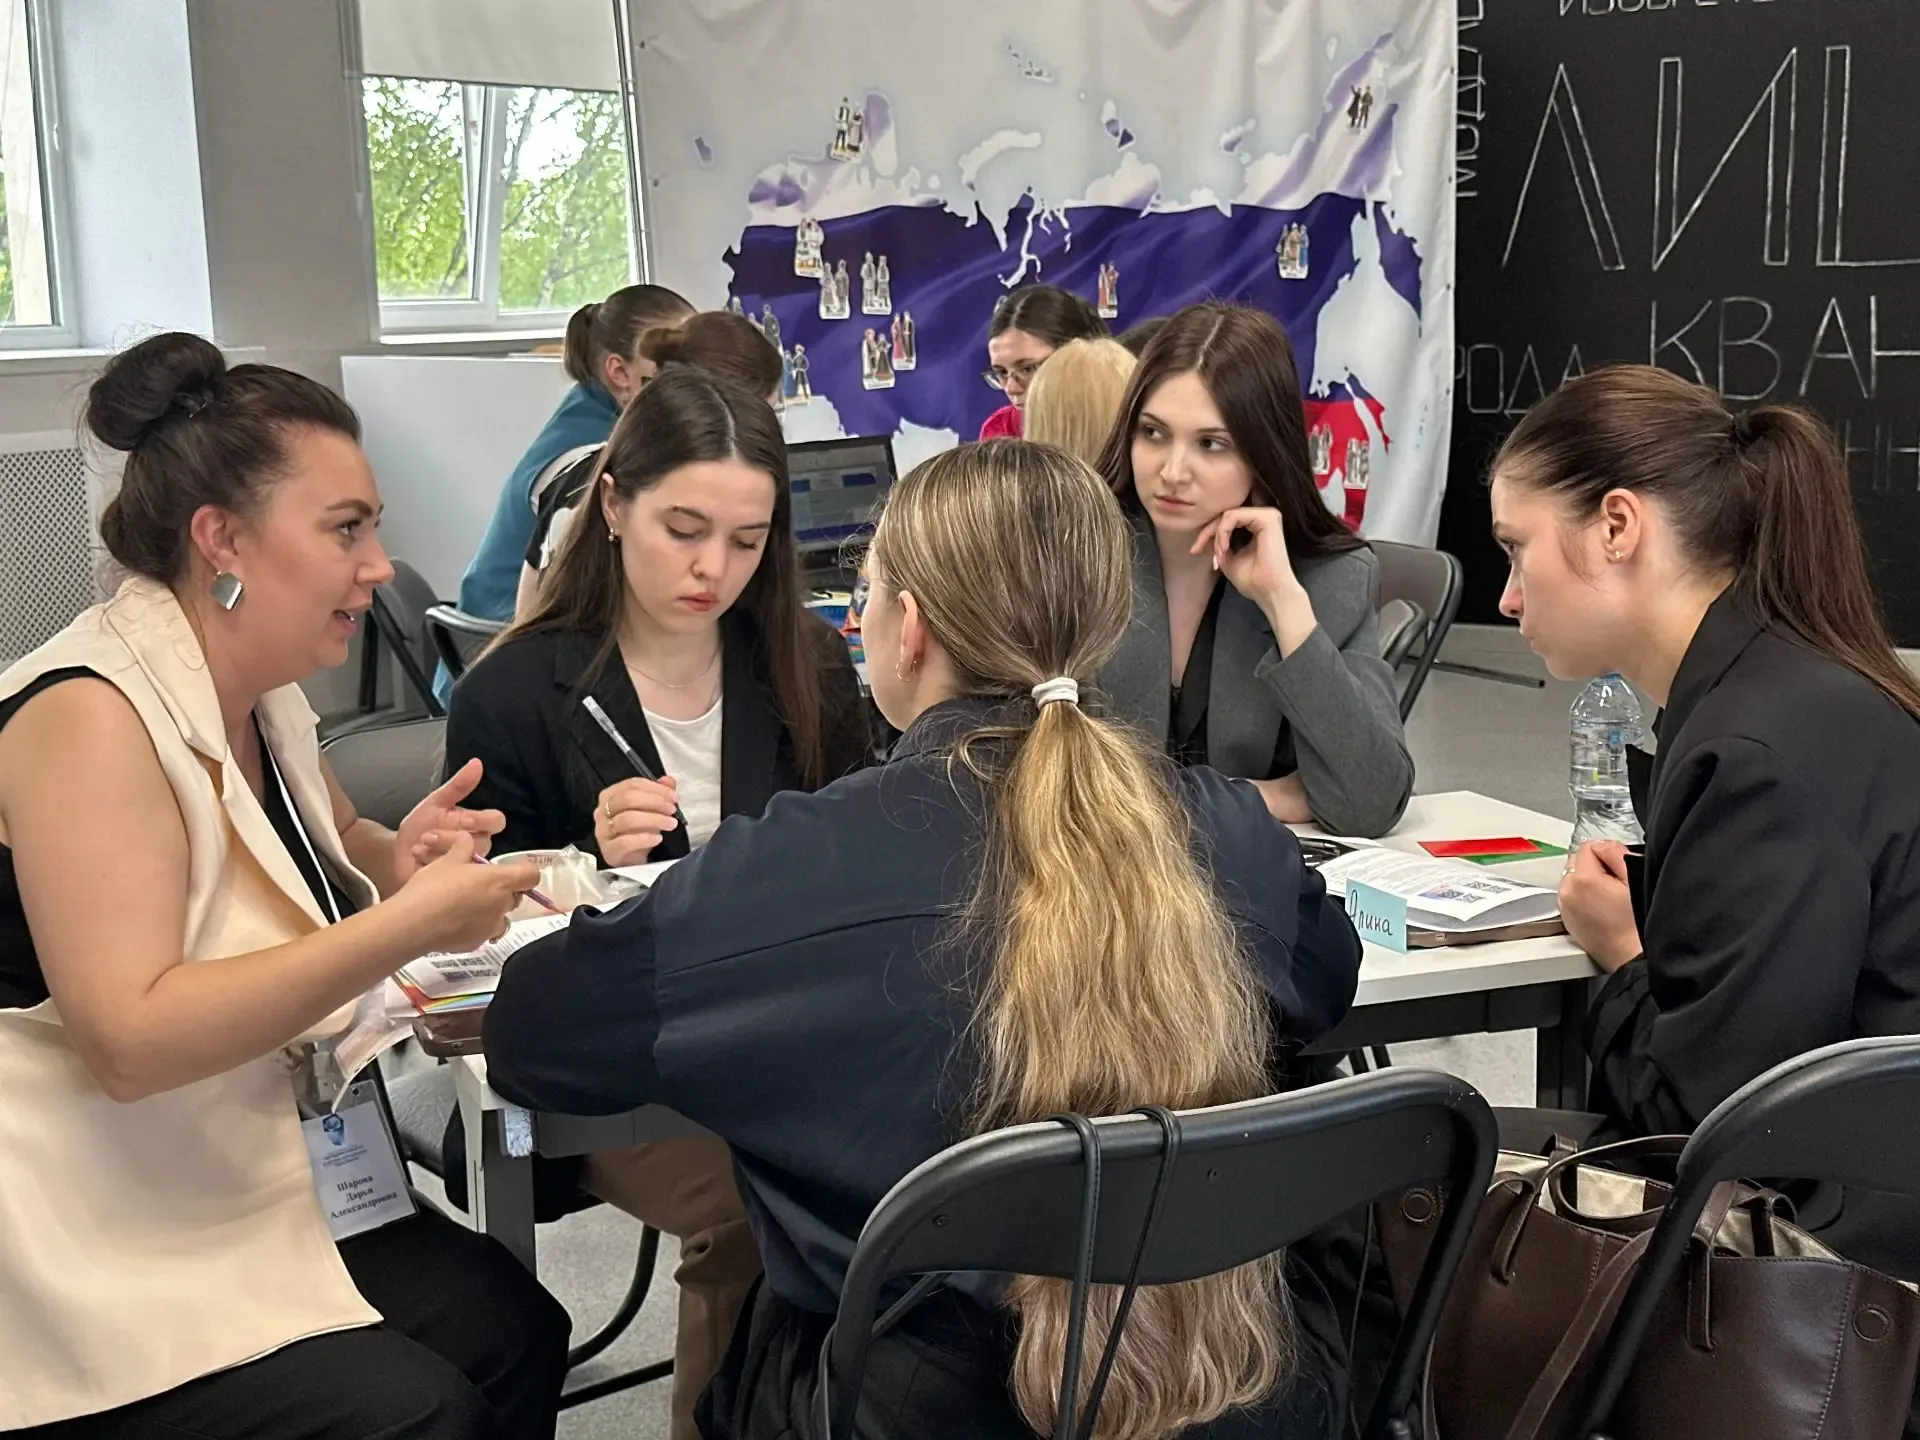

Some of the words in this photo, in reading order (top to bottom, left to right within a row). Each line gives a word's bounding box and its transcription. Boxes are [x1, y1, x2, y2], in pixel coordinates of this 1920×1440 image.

[1456, 344, 1586, 419] ОДА
[1650, 296, 1920, 401] КВАН
[1350, 889, 1393, 936] Алина
